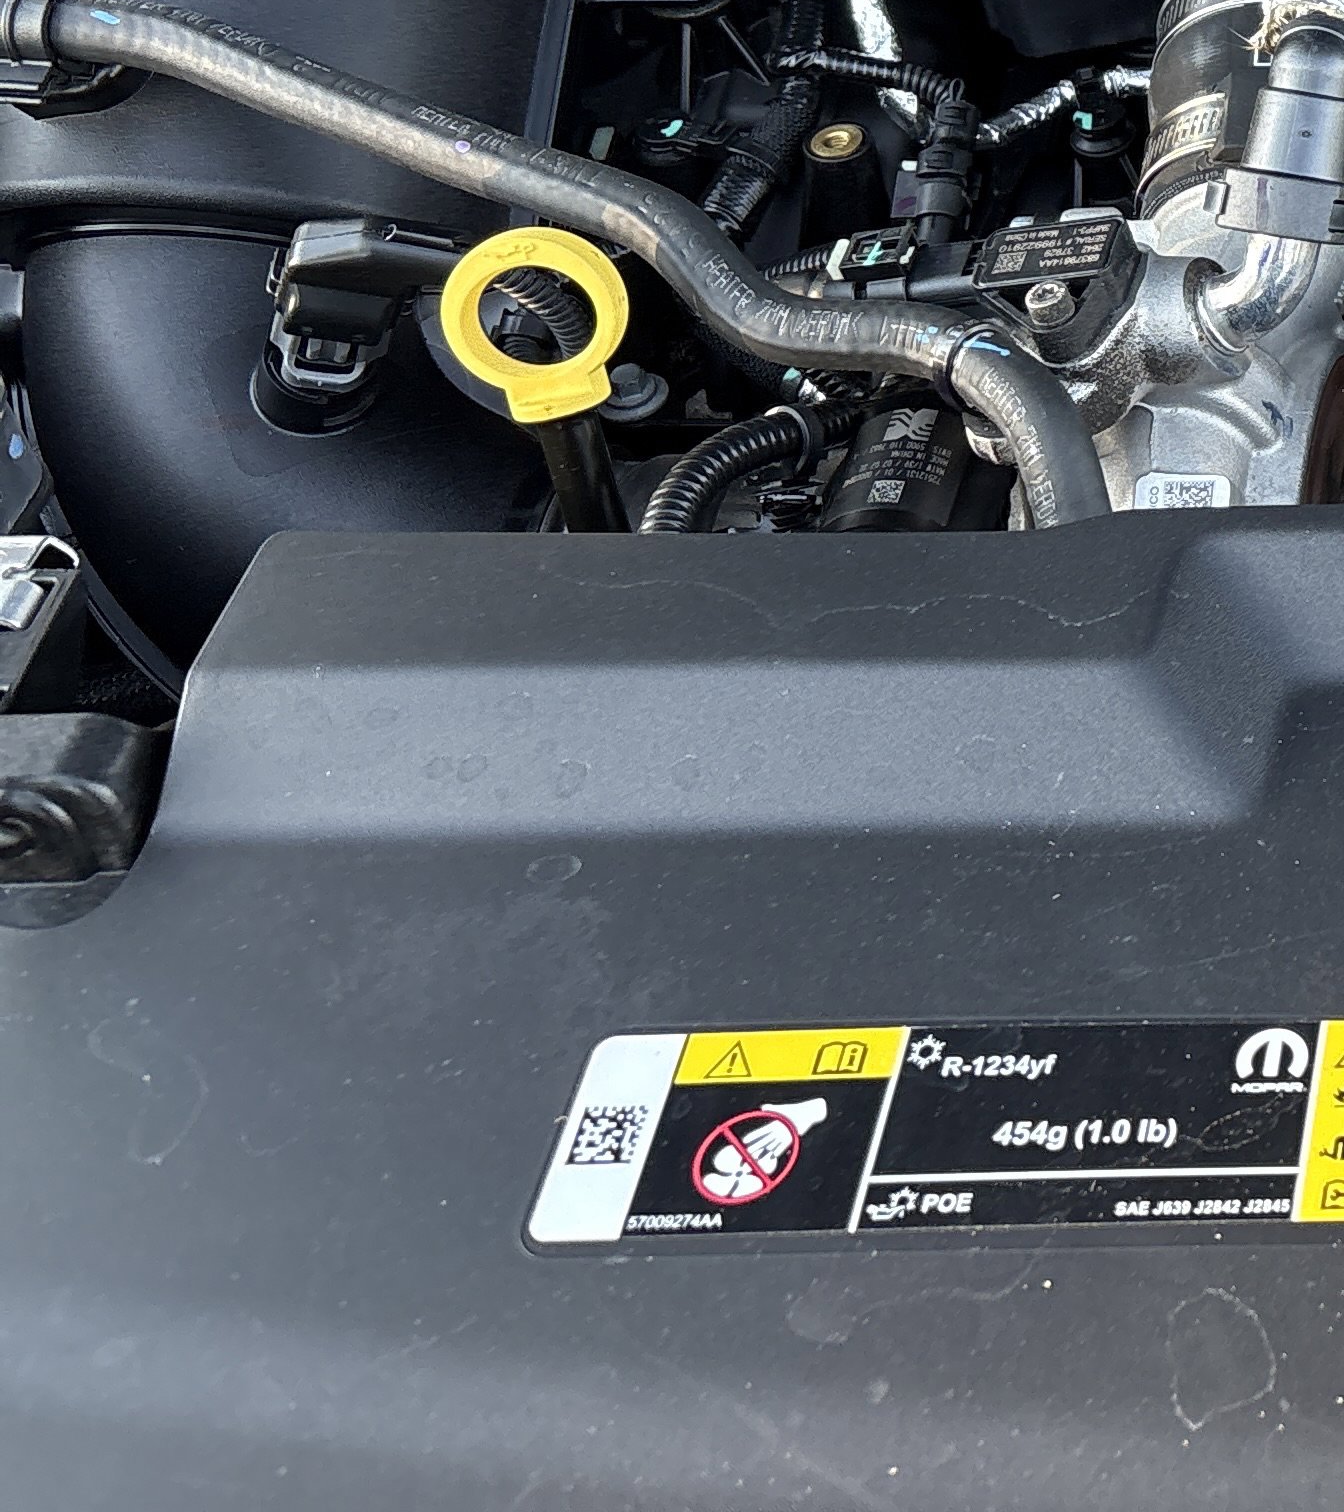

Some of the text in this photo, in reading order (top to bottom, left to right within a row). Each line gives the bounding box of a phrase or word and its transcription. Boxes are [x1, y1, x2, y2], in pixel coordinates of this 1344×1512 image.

[940, 1054, 1058, 1080] R-1234yf
[1231, 1081, 1304, 1094] MOPAR
[992, 1117, 1178, 1151] 454g (1.0 lb)
[920, 1192, 974, 1214] POE
[1114, 1198, 1290, 1217] SAE J639 J2842 J2845
[627, 1213, 724, 1230] 57009274AA
